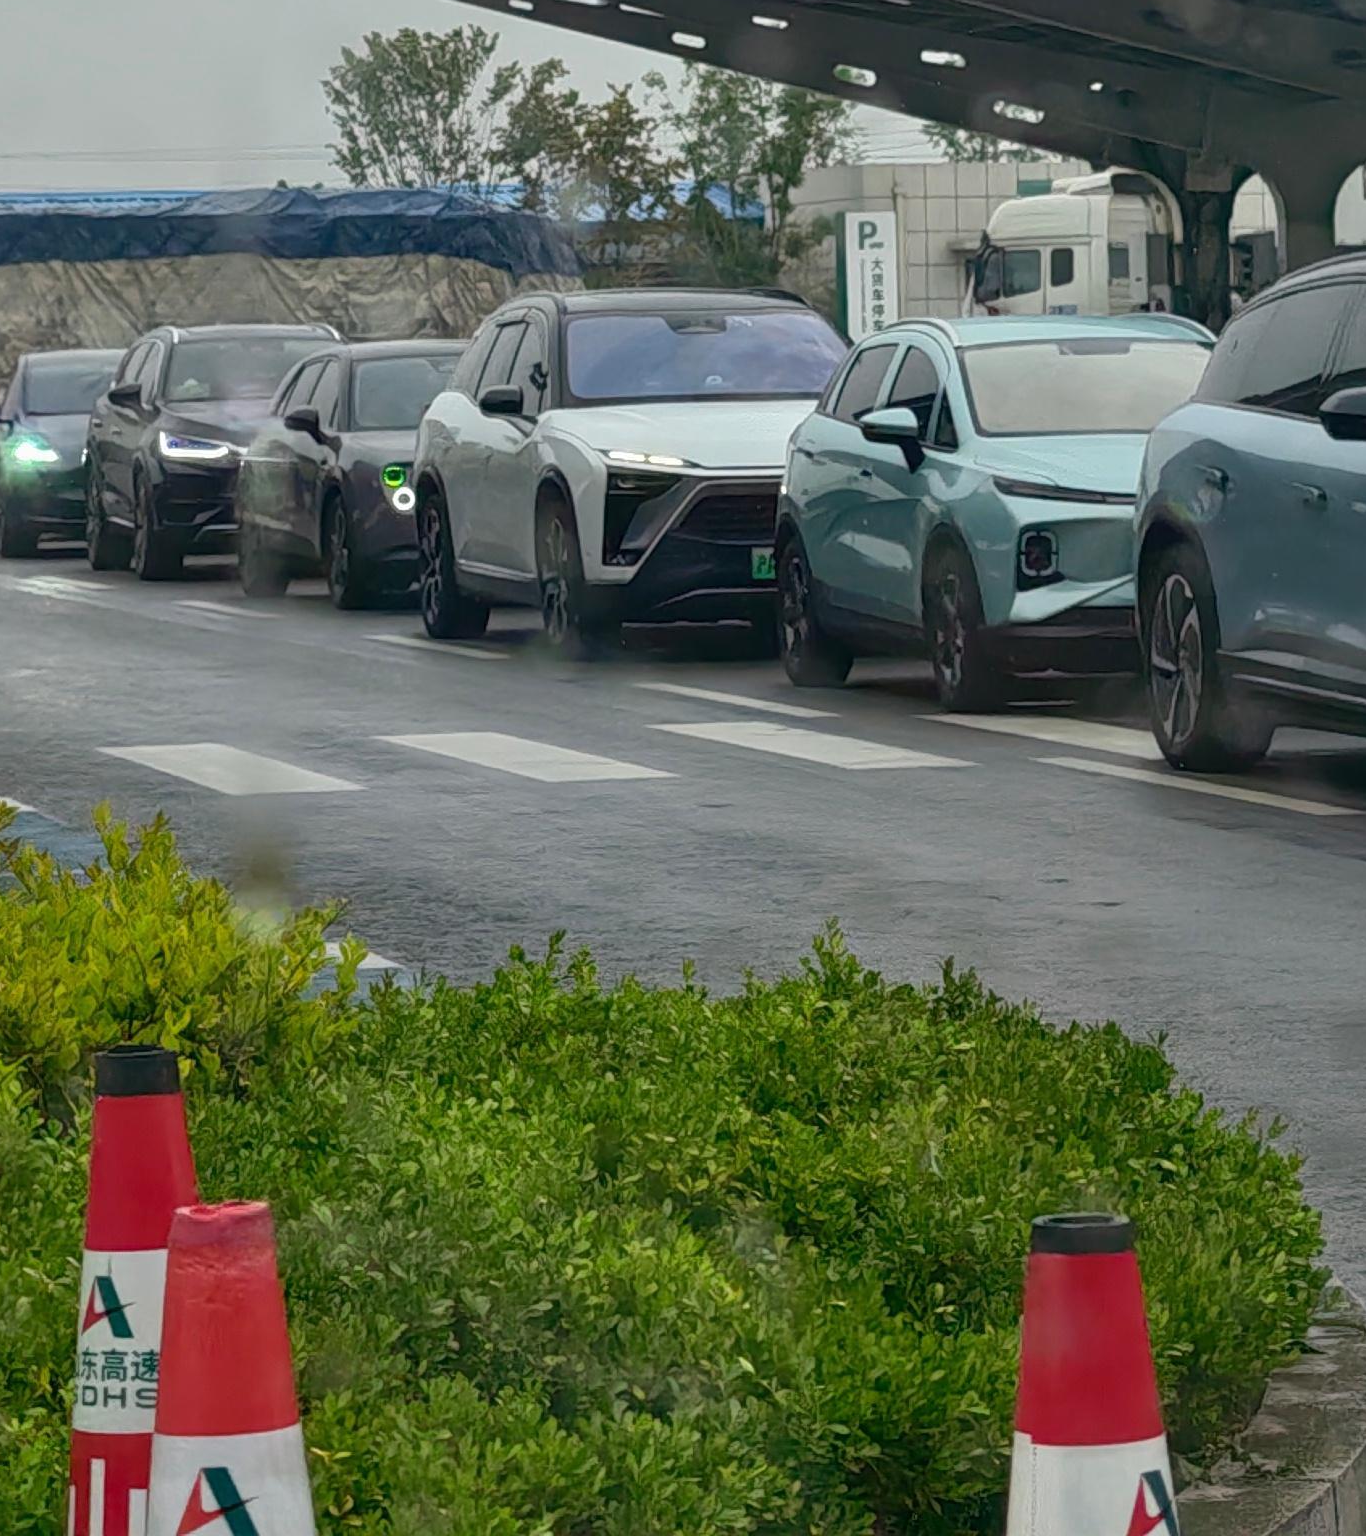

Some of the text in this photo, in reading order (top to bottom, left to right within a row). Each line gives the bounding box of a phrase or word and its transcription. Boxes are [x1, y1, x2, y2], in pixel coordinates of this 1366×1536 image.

[858, 220, 878, 251] P
[74, 1344, 161, 1383] 东高速
[74, 1385, 160, 1409] DHS
